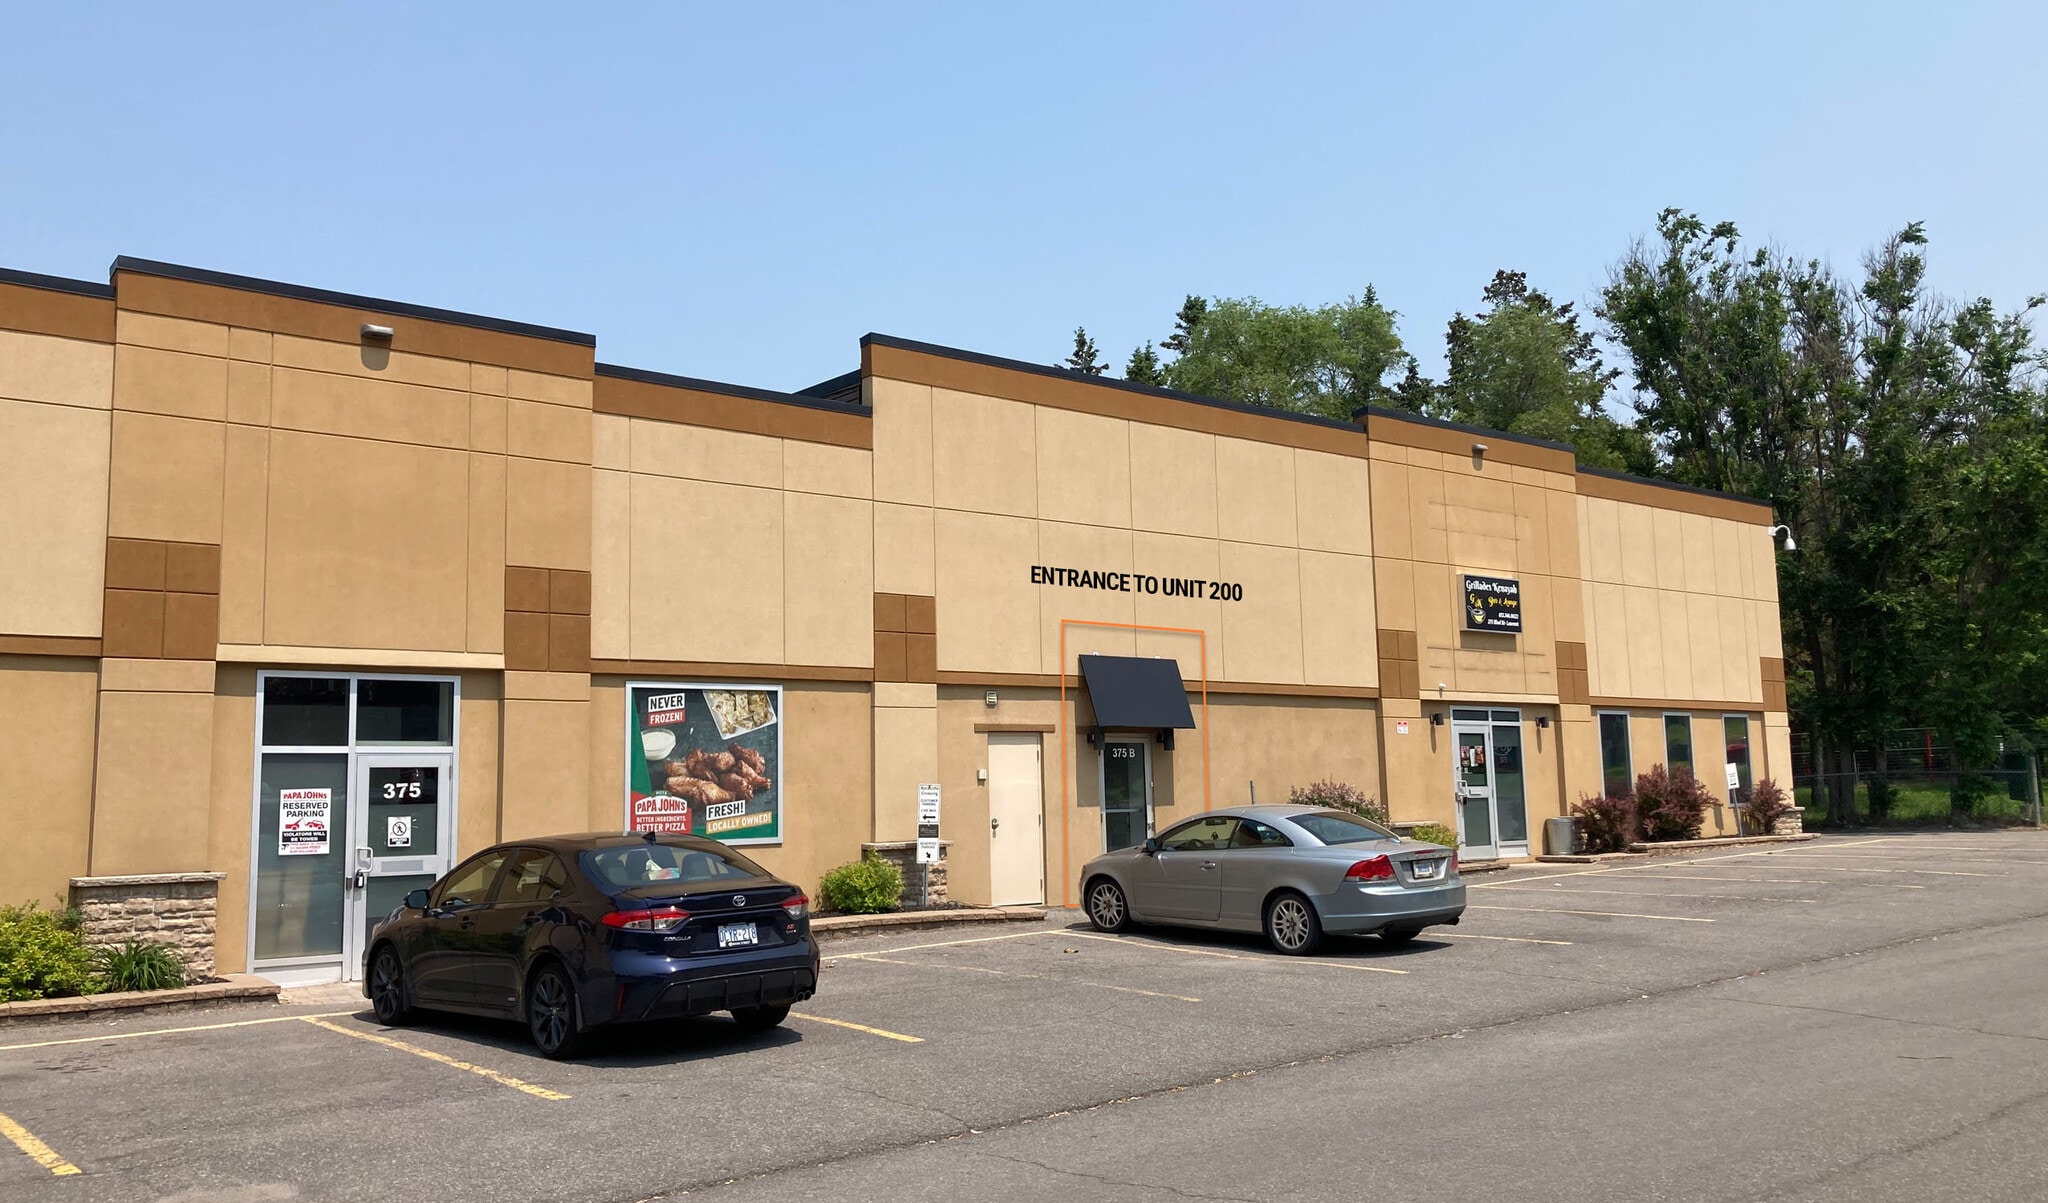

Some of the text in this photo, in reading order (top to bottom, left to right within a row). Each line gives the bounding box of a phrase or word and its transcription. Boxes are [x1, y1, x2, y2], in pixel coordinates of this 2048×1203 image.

[650, 694, 683, 710] NEVER
[650, 711, 683, 724] FROZEN!
[1112, 748, 1136, 758] 375 B
[283, 792, 302, 800] PAPA
[383, 782, 421, 799] 375
[283, 802, 328, 810] RESERVED
[637, 799, 657, 813] PAPA
[708, 801, 744, 818] FRESH!
[636, 823, 663, 832] BETTER
[708, 813, 772, 832] LOCALLY OWNED!
